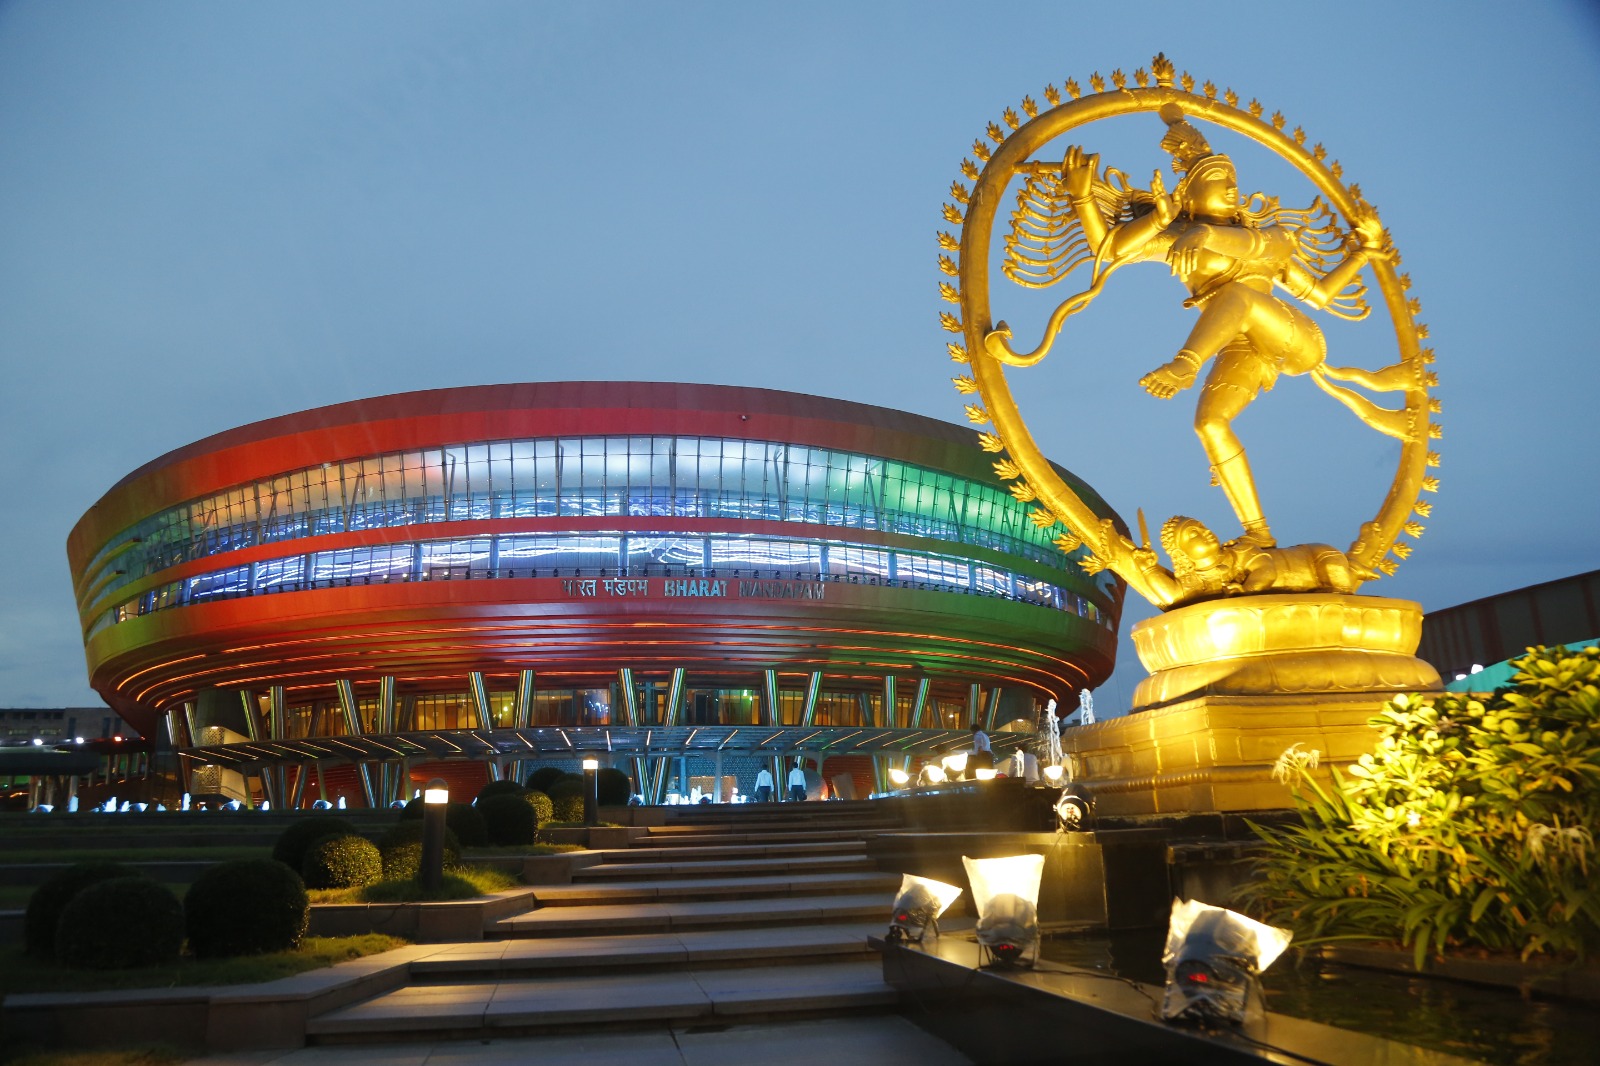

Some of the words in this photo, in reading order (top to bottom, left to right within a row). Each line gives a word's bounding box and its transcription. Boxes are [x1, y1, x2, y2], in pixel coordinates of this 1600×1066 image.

[562, 579, 597, 597] भारत
[602, 577, 648, 597] मंडपम
[664, 579, 729, 597] BHARAT
[738, 580, 825, 600] MANDAPAM
